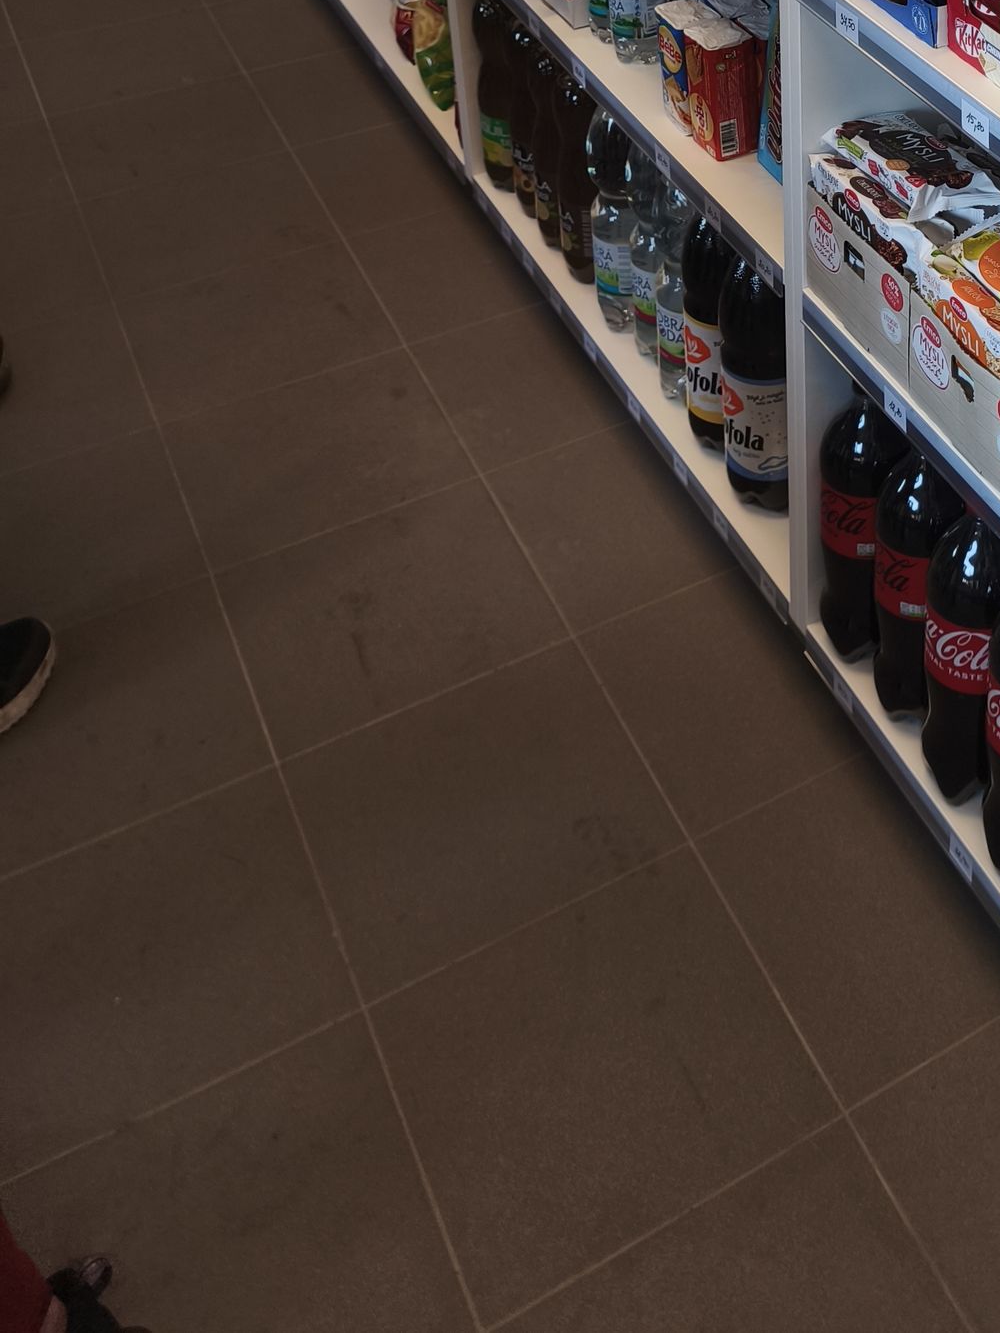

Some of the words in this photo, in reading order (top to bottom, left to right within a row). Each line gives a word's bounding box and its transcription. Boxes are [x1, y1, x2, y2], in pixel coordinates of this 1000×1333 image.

[958, 28, 986, 56] KitKat
[896, 132, 944, 163] MYSLI
[838, 198, 871, 241] MYSLI
[951, 299, 967, 320] Emco
[922, 319, 940, 345] Emco
[942, 305, 980, 357] MYSLI
[919, 332, 945, 369] MYSLI
[724, 417, 765, 451] fola
[948, 668, 984, 682] TASTE
